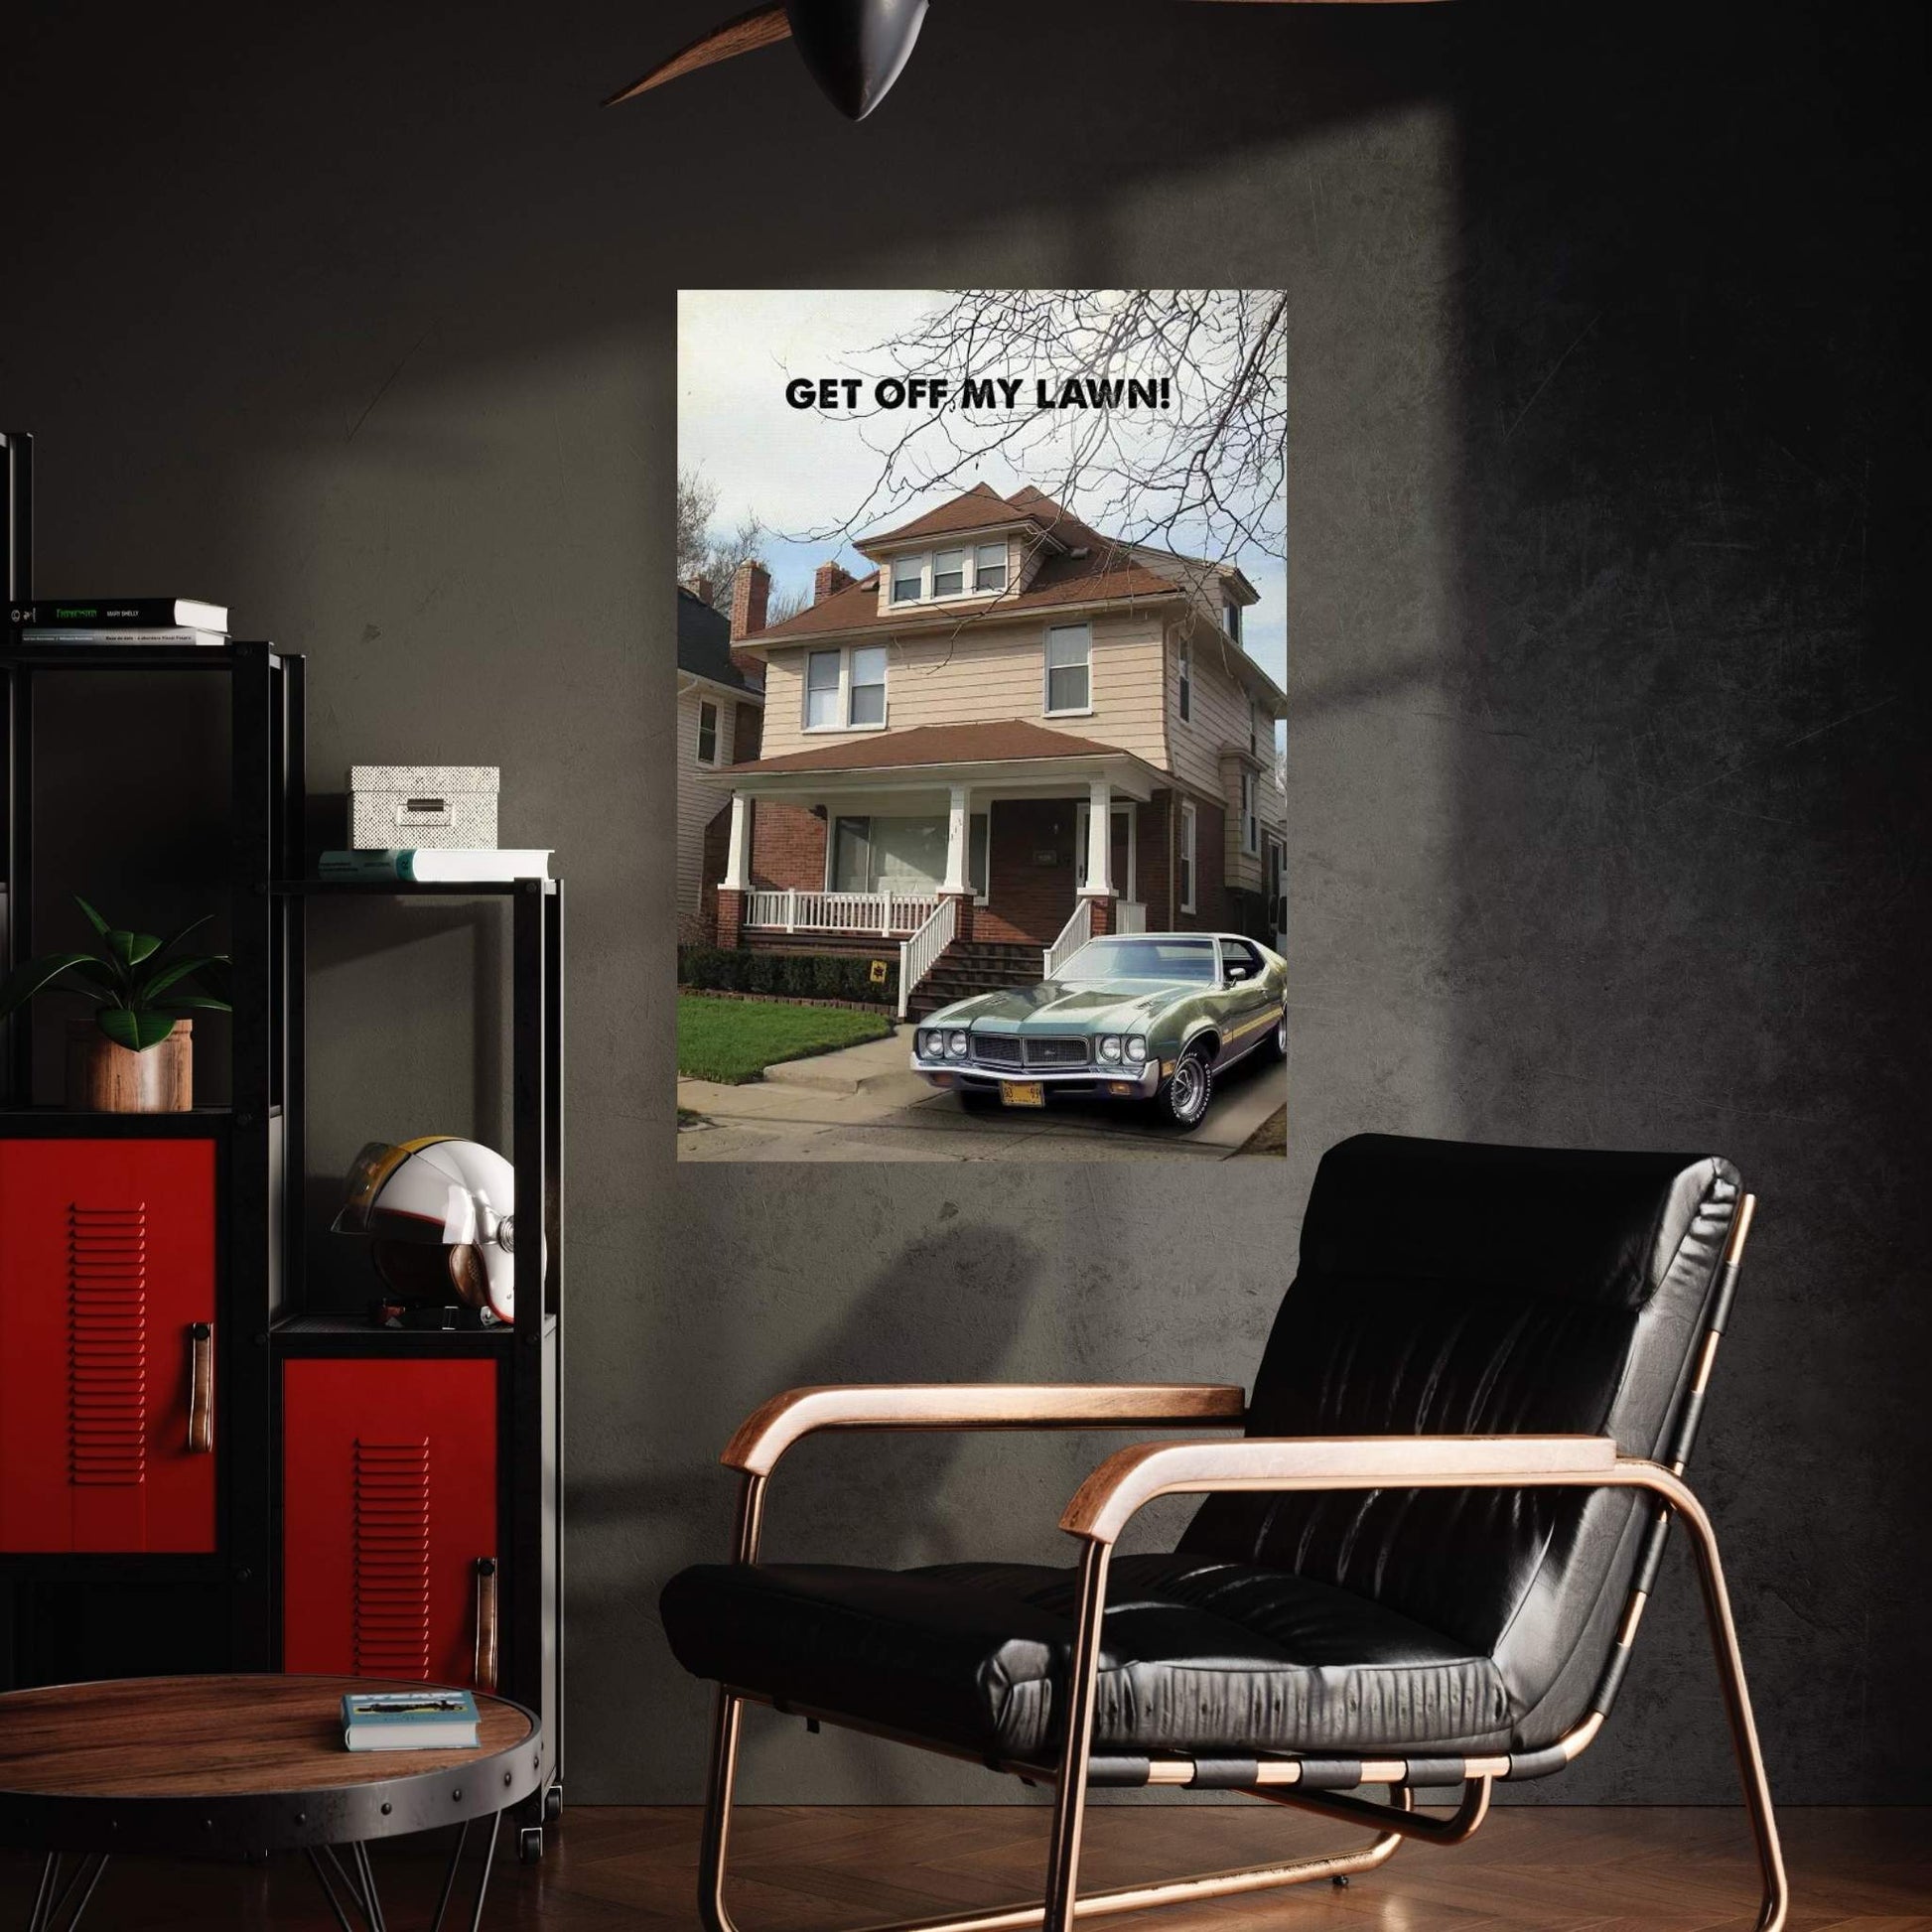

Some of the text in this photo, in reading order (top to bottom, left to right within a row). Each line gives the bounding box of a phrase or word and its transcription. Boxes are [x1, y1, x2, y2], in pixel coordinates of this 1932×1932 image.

[785, 378, 1171, 409] GET OFF MY LAWN!
